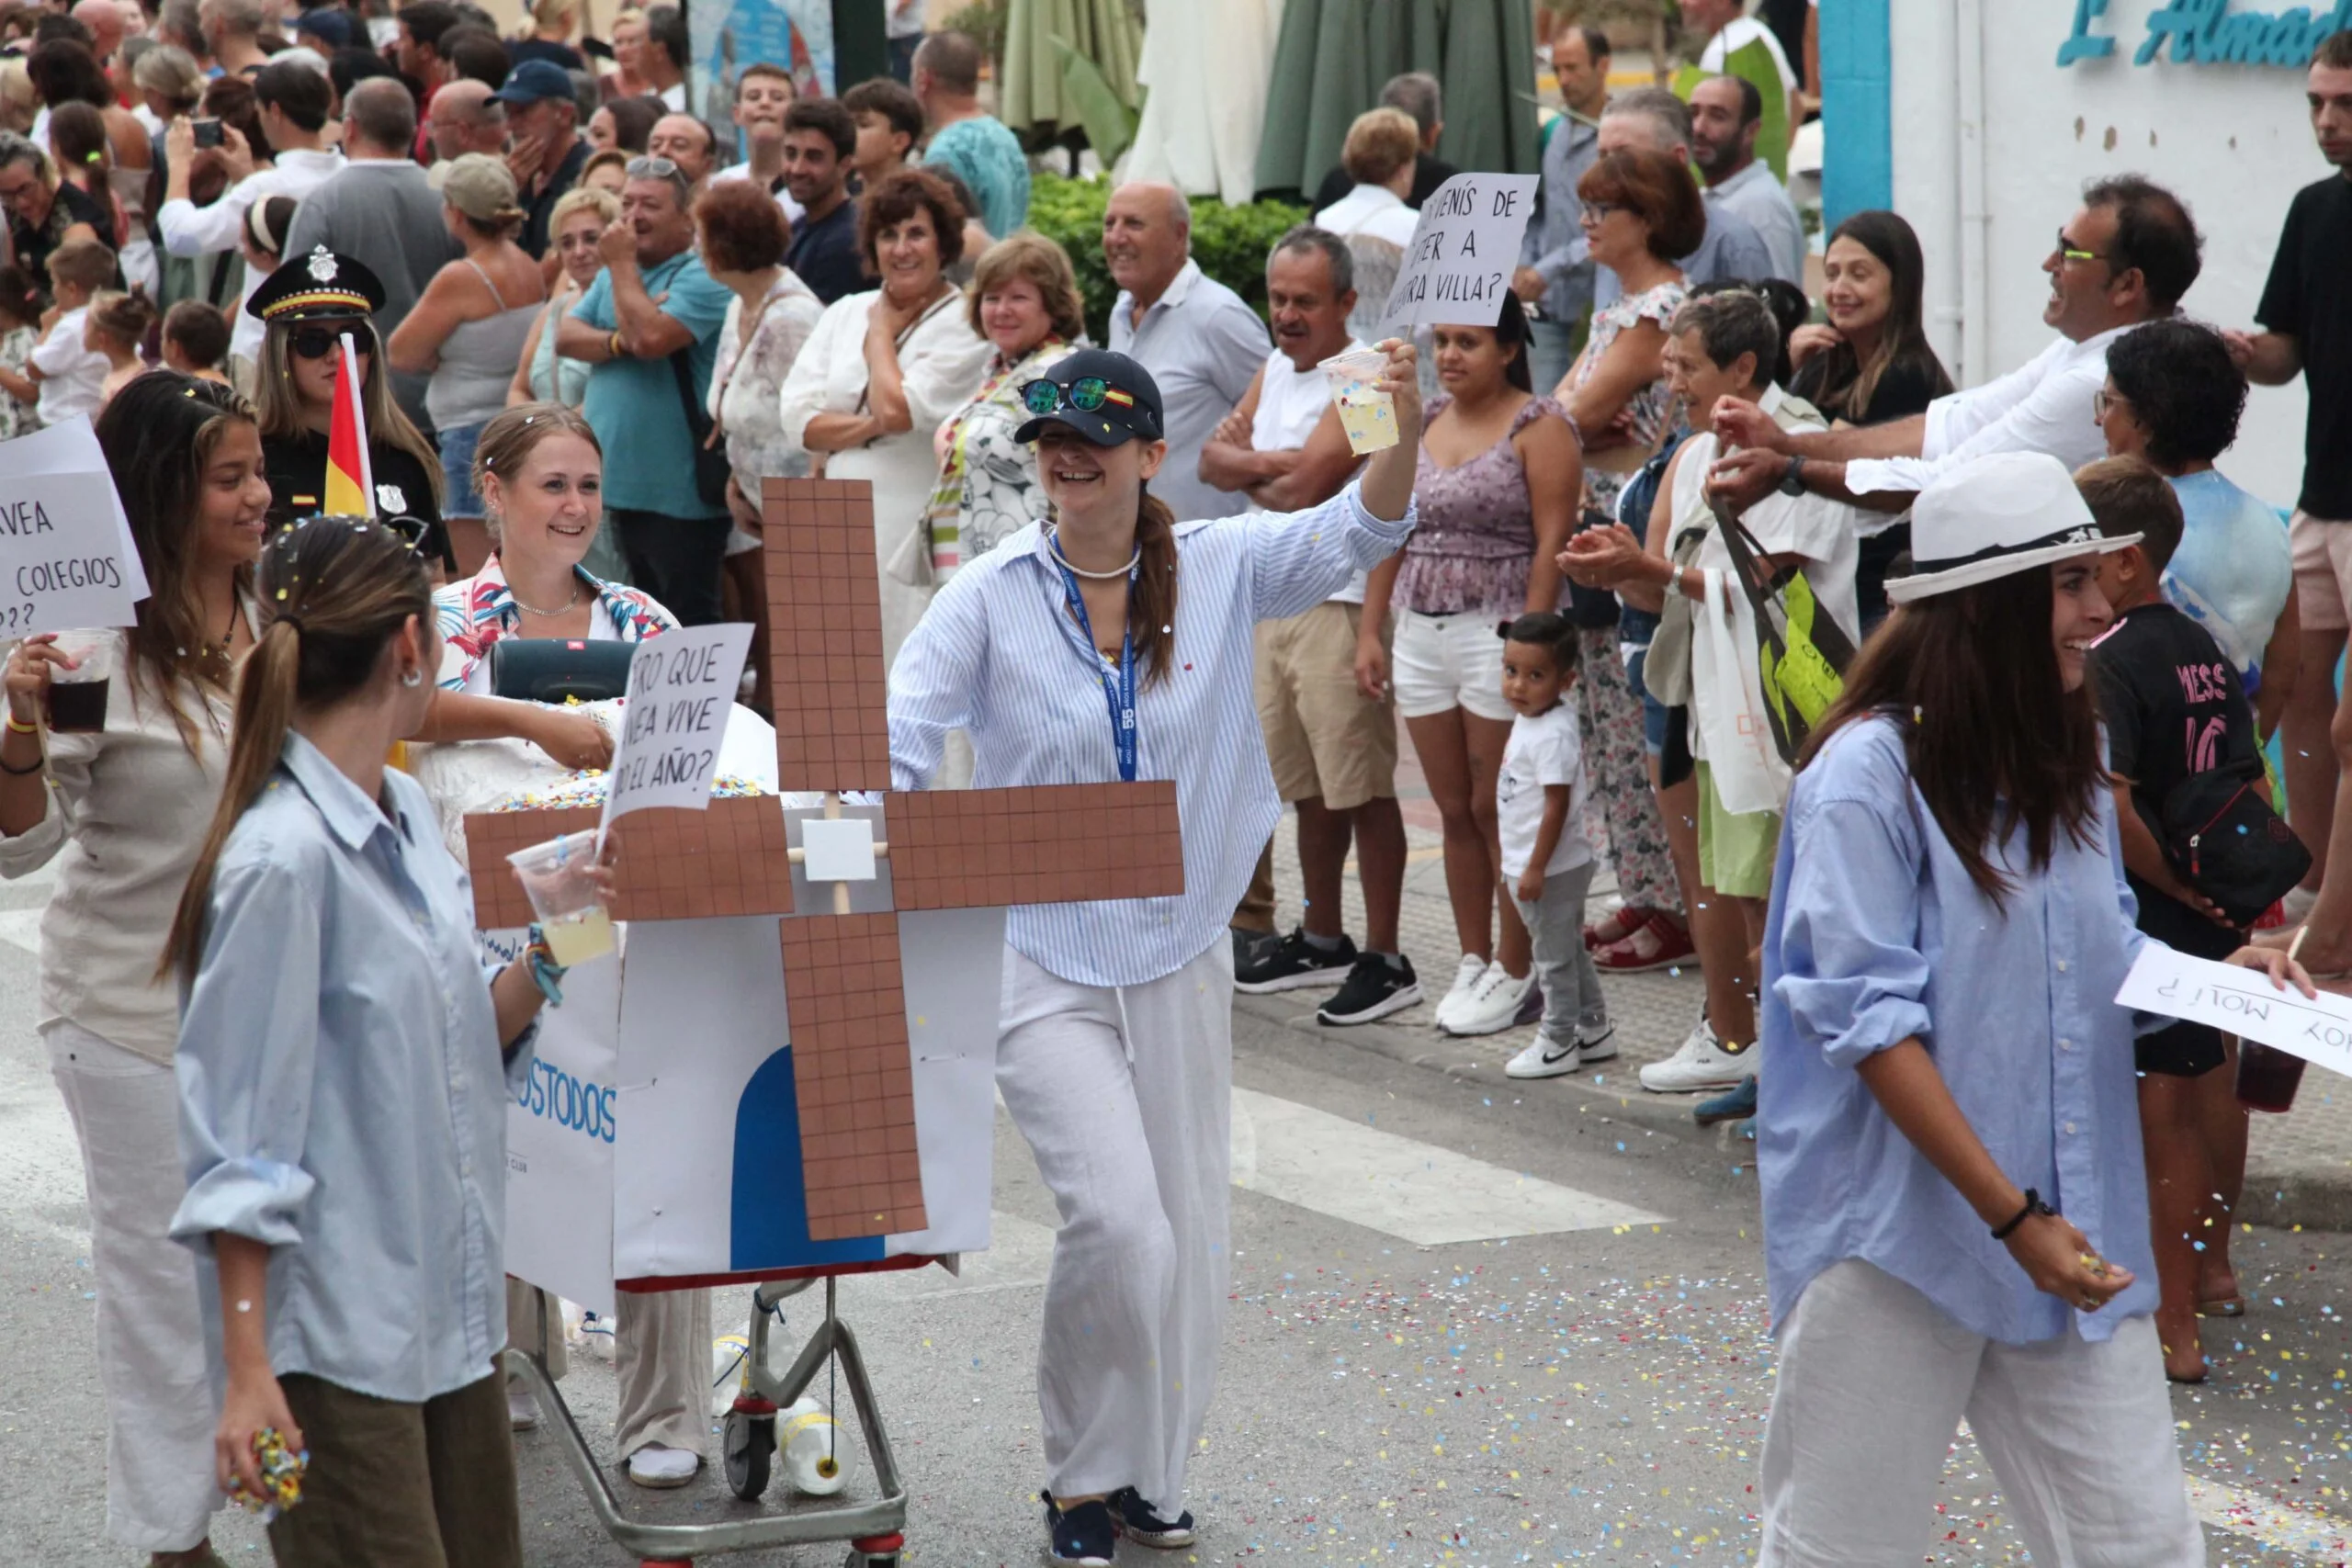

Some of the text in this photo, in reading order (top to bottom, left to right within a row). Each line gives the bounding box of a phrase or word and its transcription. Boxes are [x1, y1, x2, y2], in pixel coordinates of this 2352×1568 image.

[1493, 190, 1518, 218] DE
[1461, 230, 1476, 258] A
[1436, 272, 1502, 308] VILLA?
[17, 557, 121, 597] COLEGIOS
[668, 643, 724, 686] QUE
[665, 696, 718, 734] VIVE
[1122, 708, 1135, 729] 55
[650, 746, 714, 792] AÑO?
